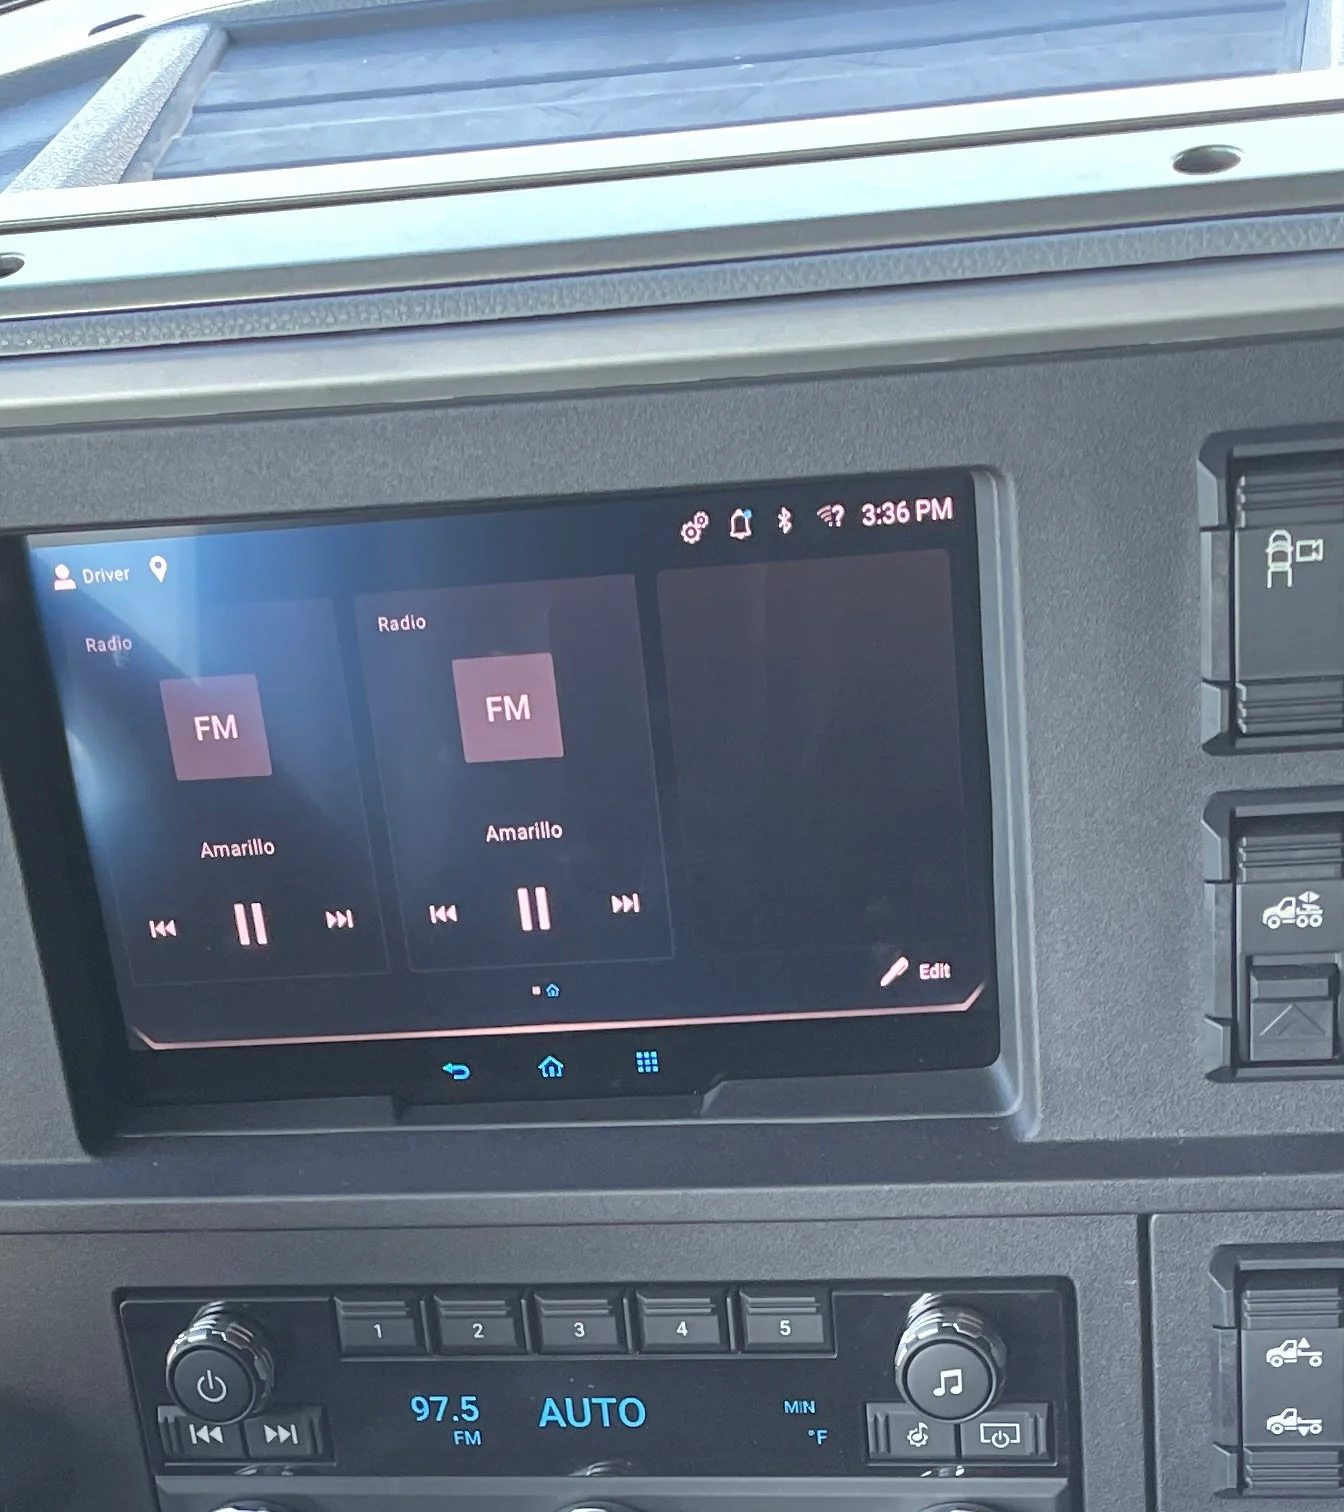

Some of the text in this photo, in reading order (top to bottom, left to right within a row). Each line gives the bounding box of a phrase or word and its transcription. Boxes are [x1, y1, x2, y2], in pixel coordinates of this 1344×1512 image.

[862, 498, 953, 527] 3:36 PM
[82, 566, 130, 586] Driver
[377, 613, 427, 633] Radio
[85, 634, 133, 654] Radio
[485, 695, 531, 722] FM
[194, 715, 238, 741] FM
[485, 821, 563, 843] Amarillo
[200, 837, 276, 858] Amarillo
[918, 961, 951, 981] Edit
[373, 1323, 383, 1339] 1
[473, 1323, 484, 1339] 2
[574, 1322, 585, 1338] 3
[676, 1321, 688, 1337] 4
[779, 1320, 791, 1336] 5
[410, 1396, 481, 1423] 97.5
[538, 1397, 647, 1428] AUTO
[783, 1400, 816, 1414] MIN
[453, 1431, 482, 1447] FM
